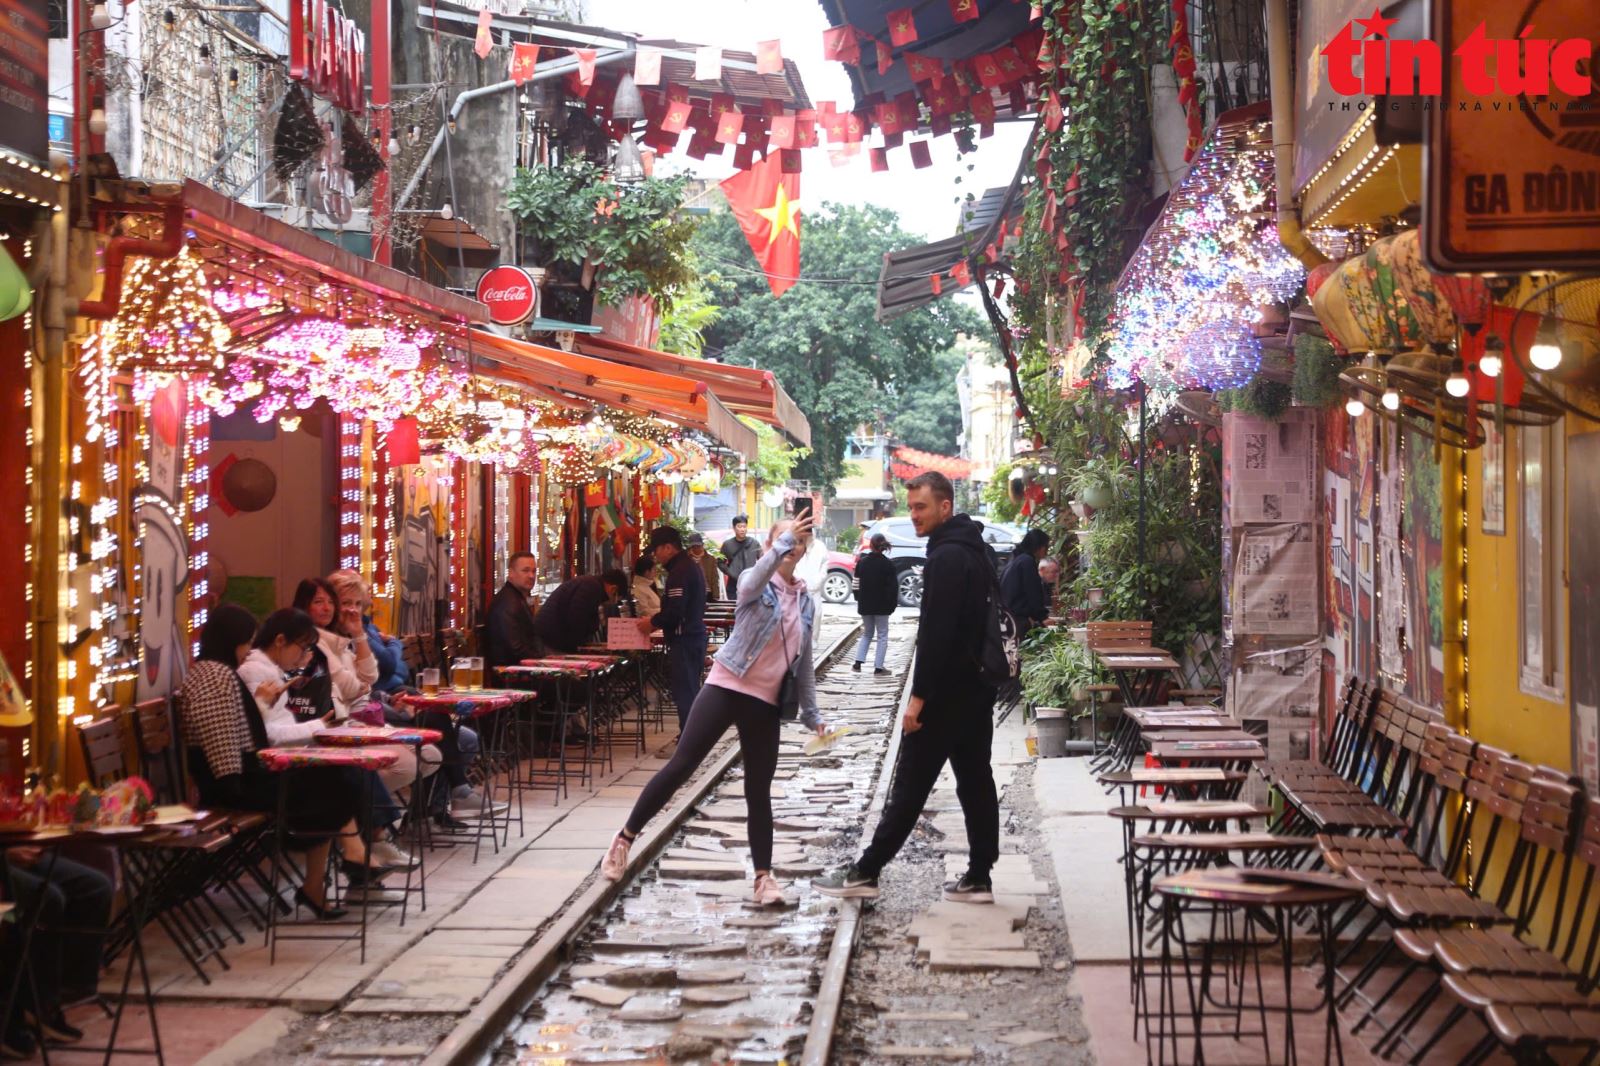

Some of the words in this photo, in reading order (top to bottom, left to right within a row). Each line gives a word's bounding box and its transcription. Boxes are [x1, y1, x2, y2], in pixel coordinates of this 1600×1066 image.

[1465, 174, 1510, 214] GA
[1522, 164, 1600, 213] ĐÔN
[483, 285, 528, 303] Coca-Cola
